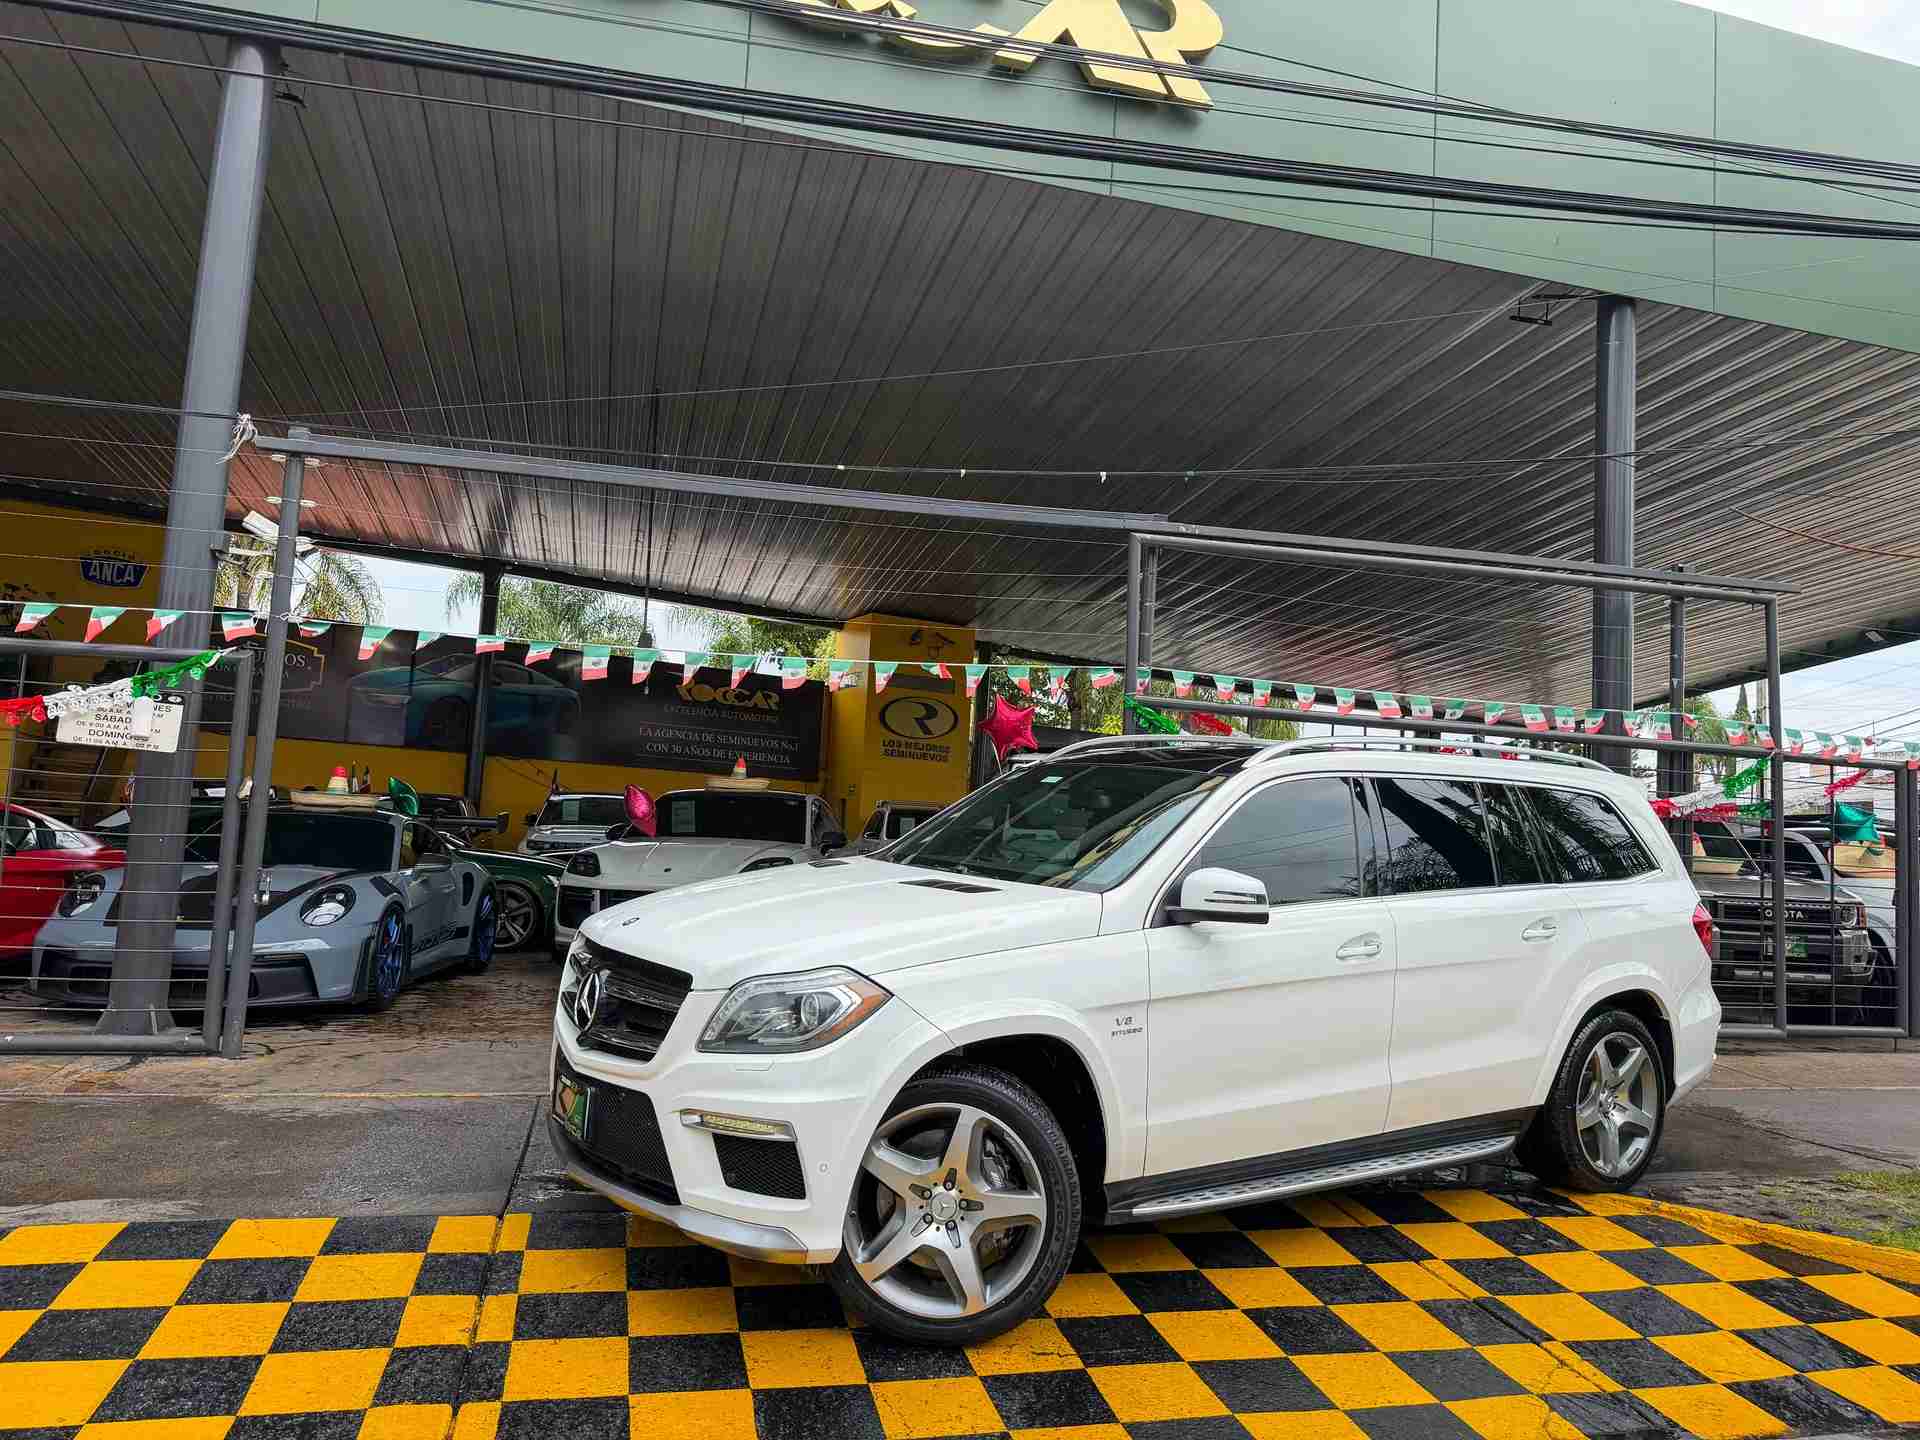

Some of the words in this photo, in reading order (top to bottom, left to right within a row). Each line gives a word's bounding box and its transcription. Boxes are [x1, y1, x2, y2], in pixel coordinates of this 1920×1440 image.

[88, 560, 136, 584] ANCA
[645, 743, 670, 754] CON
[883, 748, 950, 763] SEMINUEVOS
